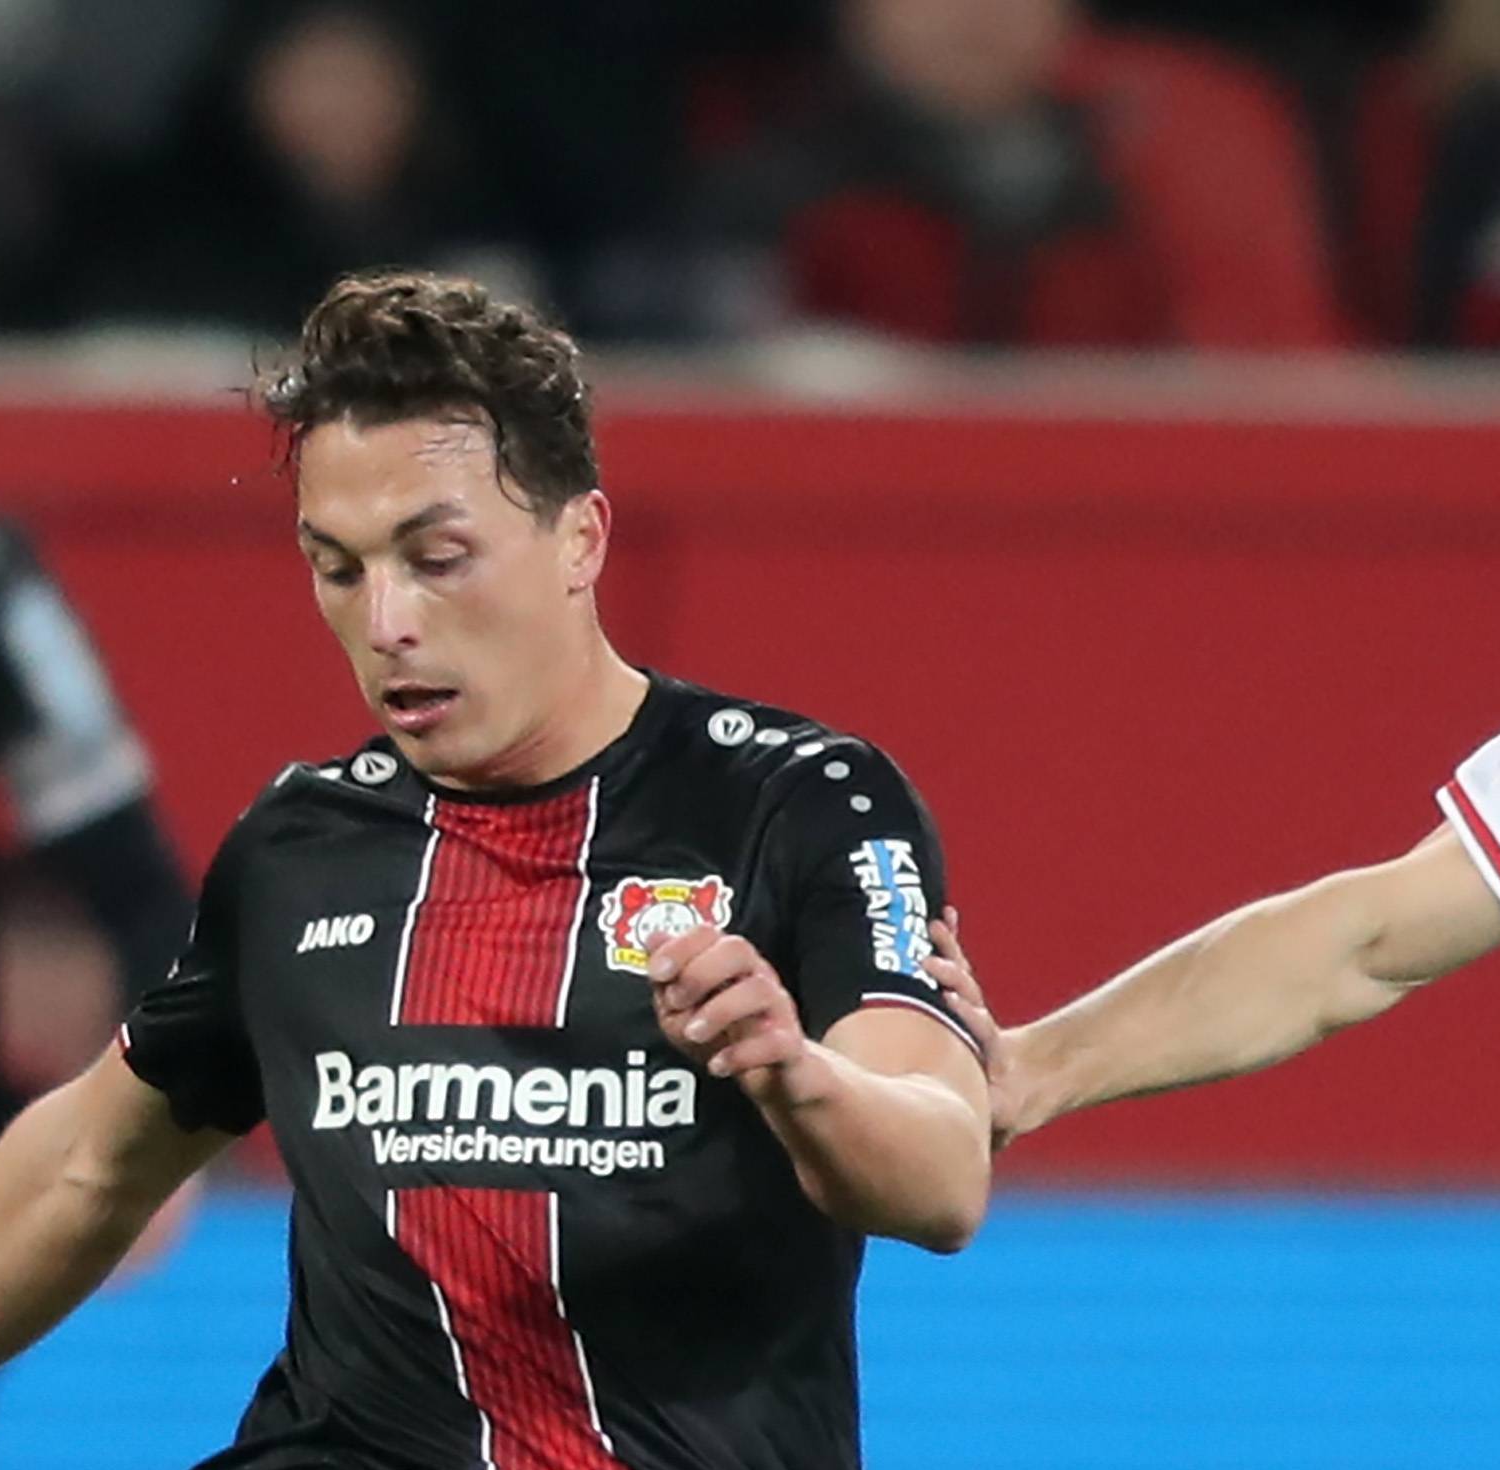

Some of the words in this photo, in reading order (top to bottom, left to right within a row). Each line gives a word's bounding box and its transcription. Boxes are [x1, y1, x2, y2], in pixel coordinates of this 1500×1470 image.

[296, 913, 375, 954] JAKO
[311, 1050, 697, 1130] Barmenia
[371, 1126, 665, 1176] Versicherungen
